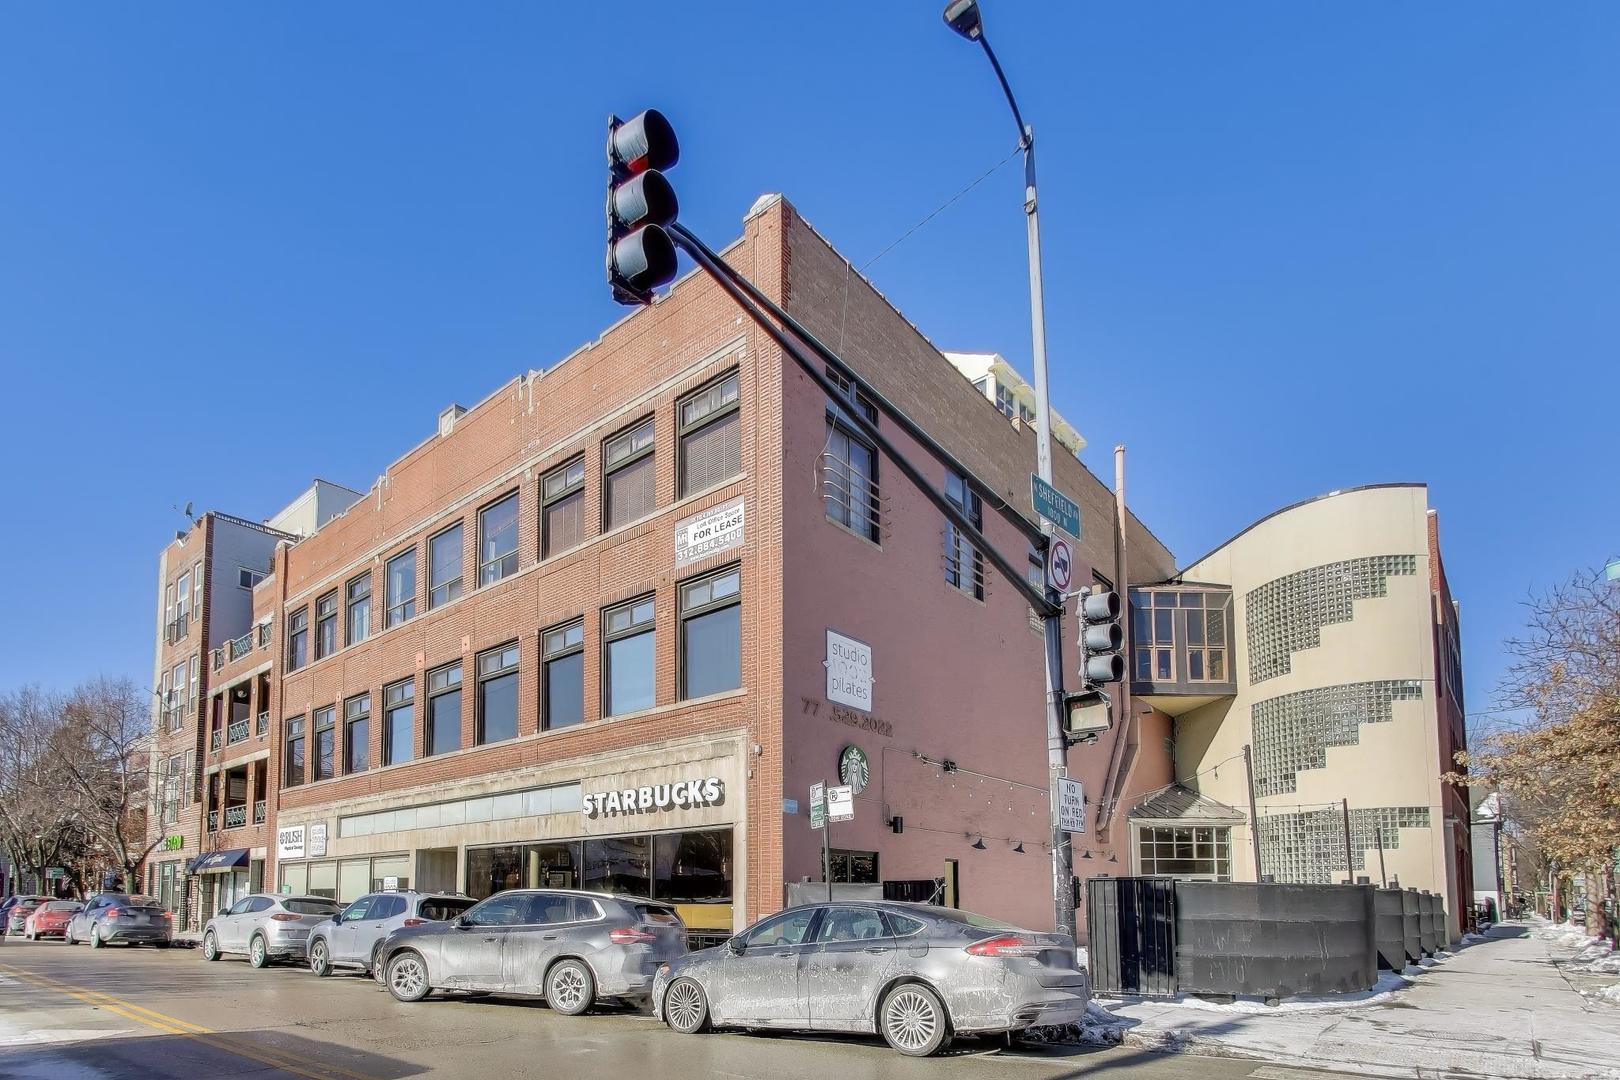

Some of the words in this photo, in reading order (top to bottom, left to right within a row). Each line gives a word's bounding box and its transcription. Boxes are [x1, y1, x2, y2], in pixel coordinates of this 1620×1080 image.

[1039, 483, 1073, 518] SHEFFIELD
[694, 528, 711, 541] FOR
[714, 514, 743, 533] LEASE
[708, 515, 724, 525] Office
[832, 643, 868, 666] studio
[832, 677, 868, 700] pilates
[582, 777, 720, 816] STARBUCKS
[1064, 794, 1080, 806] TURN
[1066, 783, 1076, 794] NO
[1061, 805, 1070, 816] ON
[1072, 807, 1083, 818] RED
